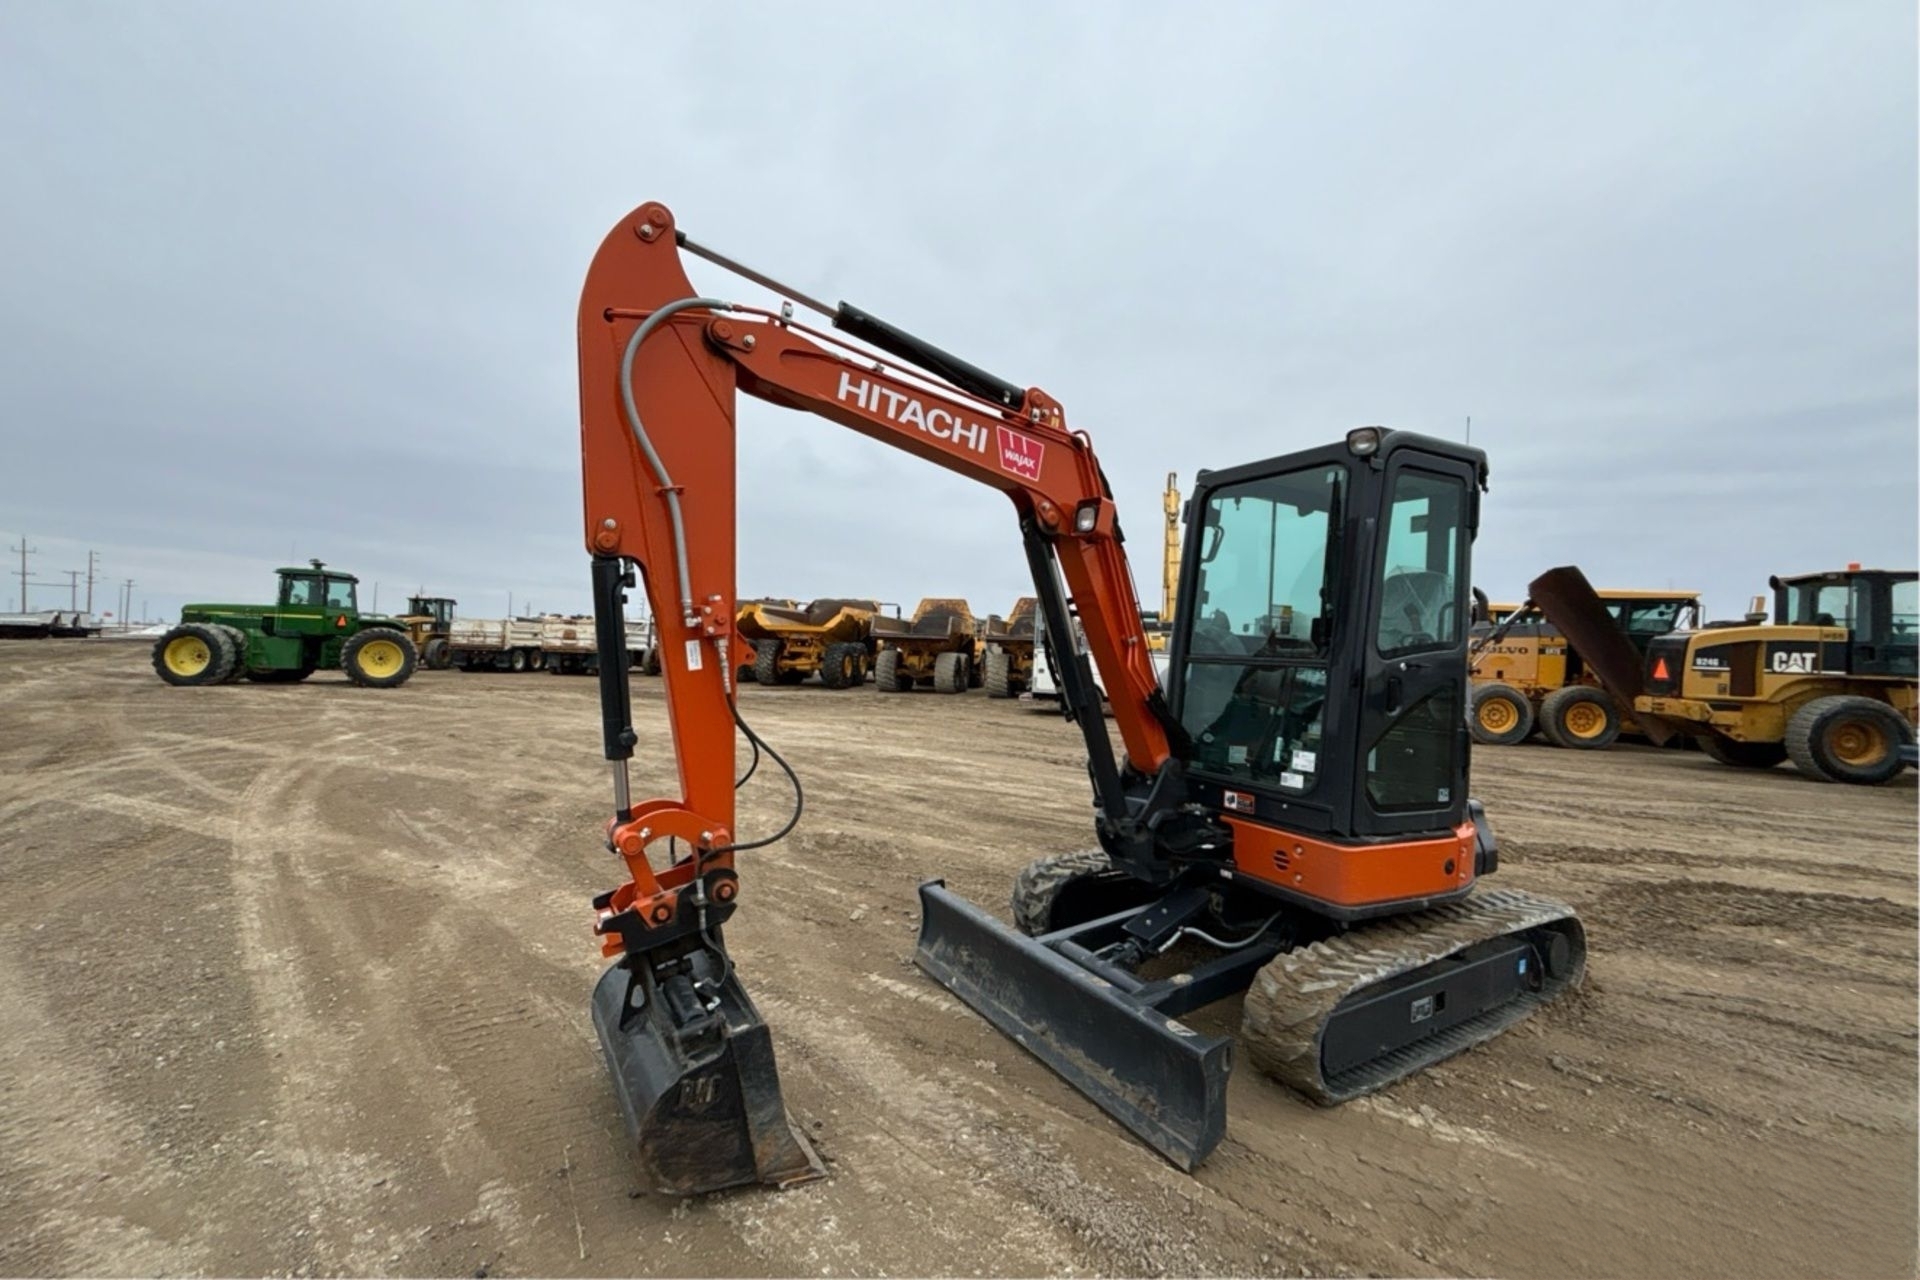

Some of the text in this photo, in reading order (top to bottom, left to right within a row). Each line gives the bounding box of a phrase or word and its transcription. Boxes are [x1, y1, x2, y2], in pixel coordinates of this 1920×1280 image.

[837, 371, 988, 453] HITACHI
[1005, 449, 1035, 469] WAJAX
[1773, 651, 1817, 672] CAT
